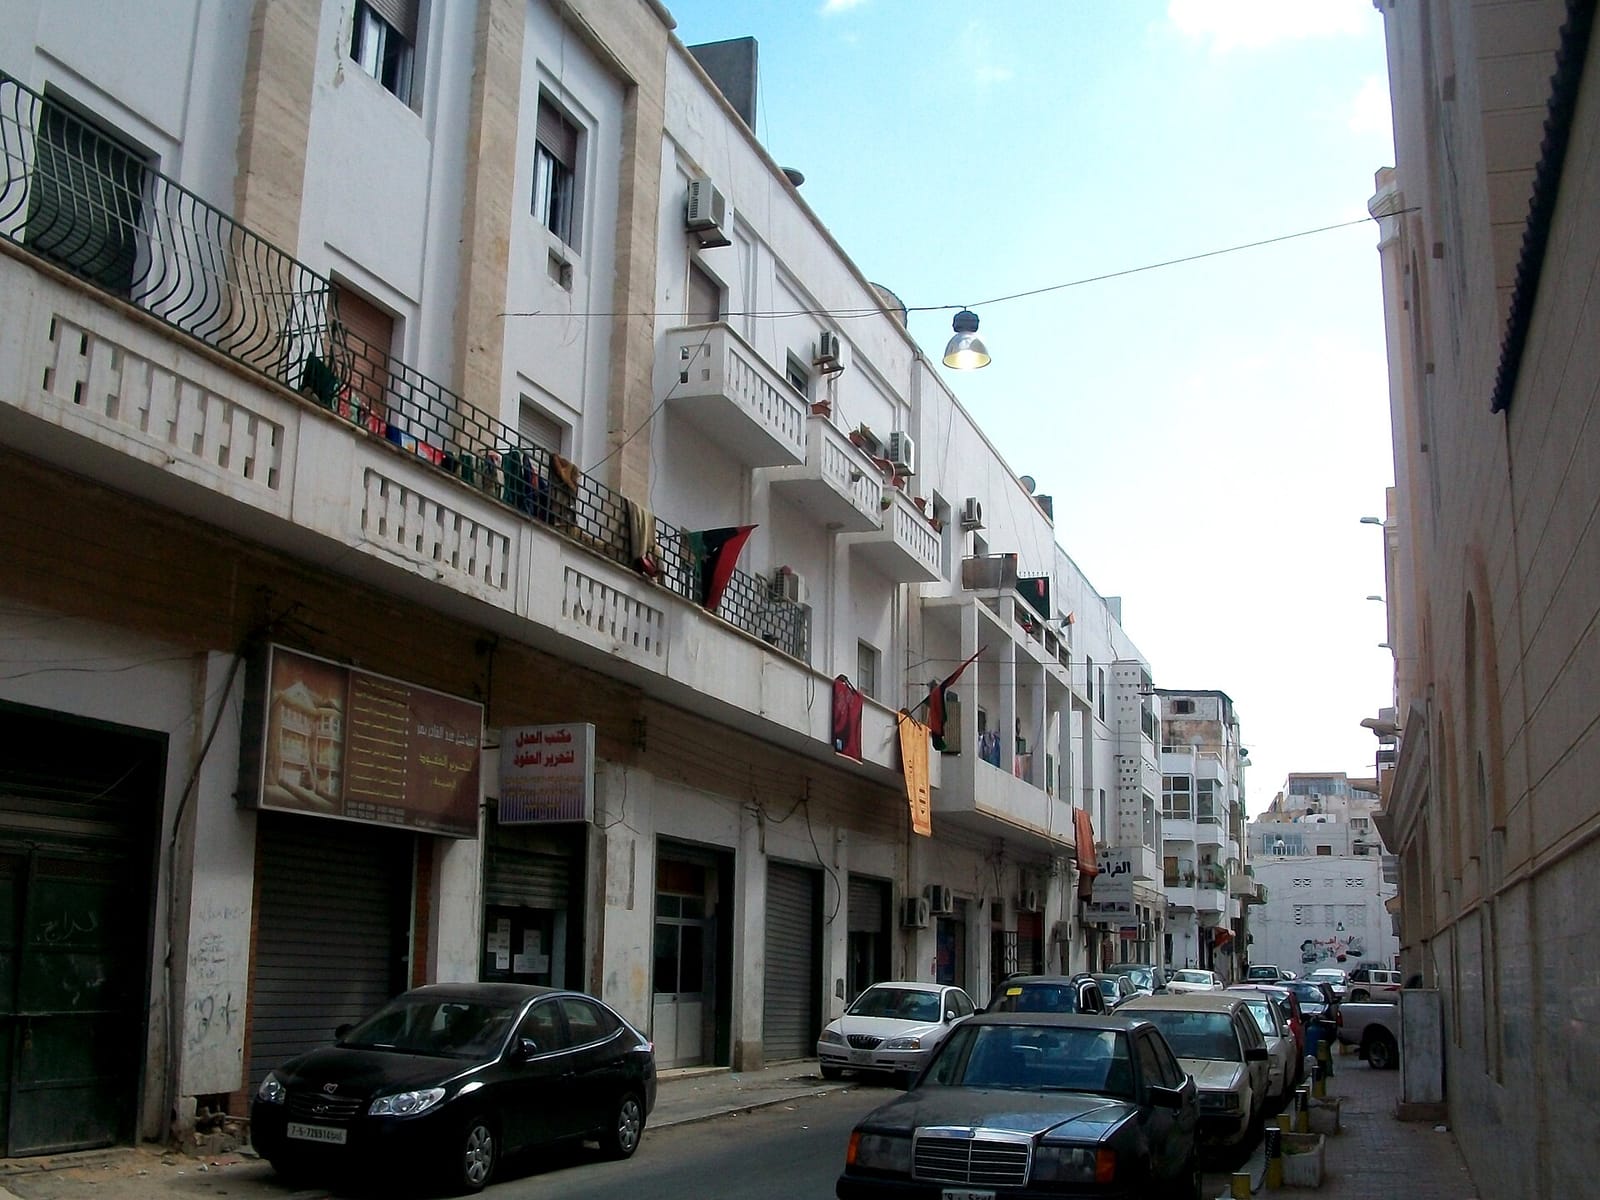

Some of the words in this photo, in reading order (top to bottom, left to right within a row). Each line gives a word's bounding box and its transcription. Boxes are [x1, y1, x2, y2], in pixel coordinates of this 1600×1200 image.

[515, 731, 542, 748] العدل
[544, 729, 572, 746] مكتب
[513, 751, 542, 769] العقود
[543, 749, 575, 768] لتحرير
